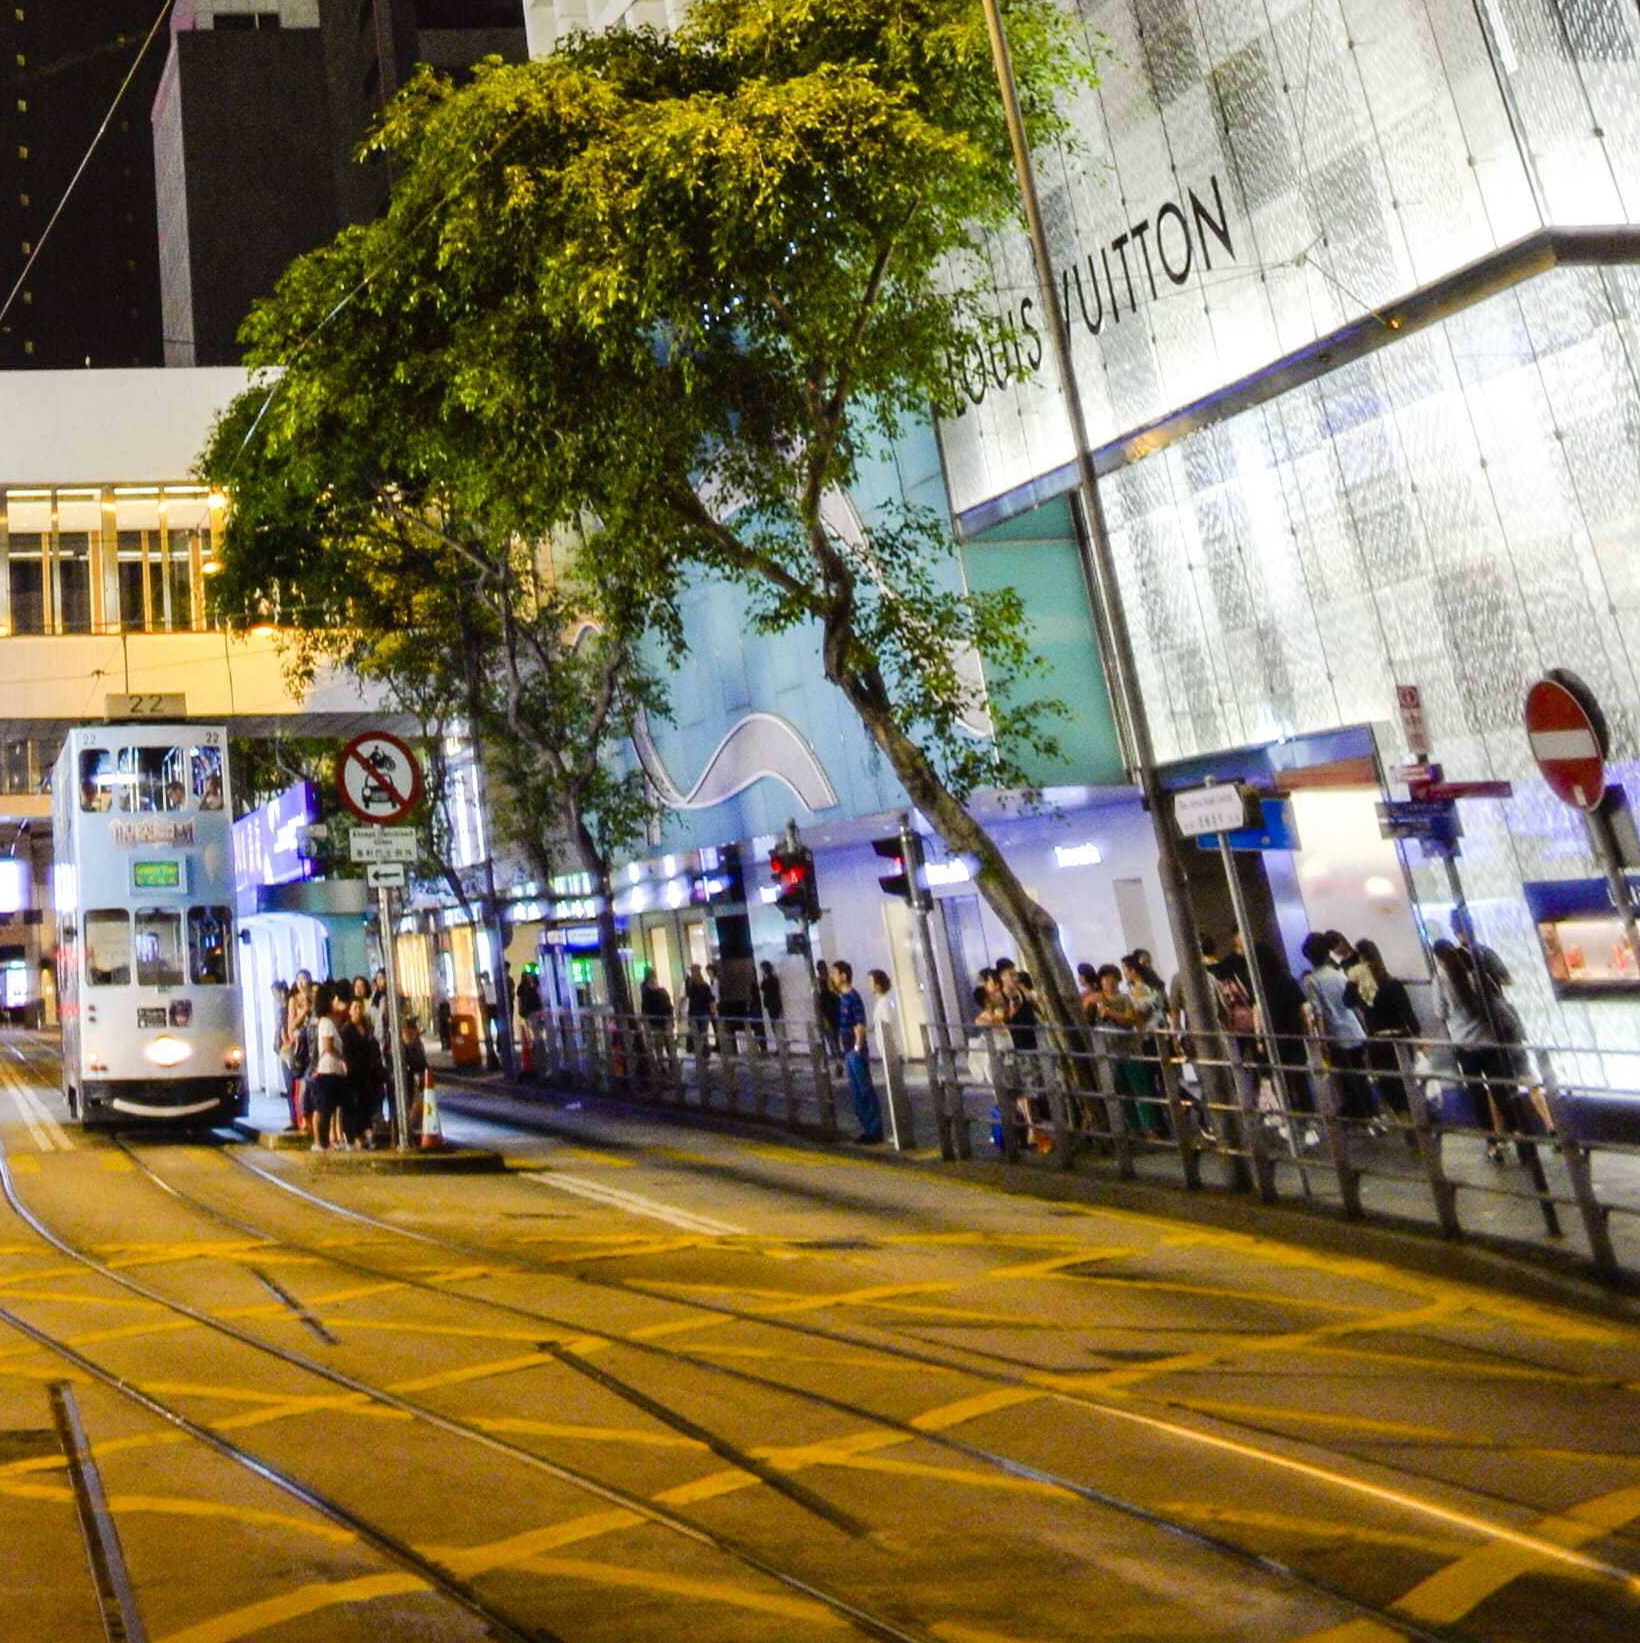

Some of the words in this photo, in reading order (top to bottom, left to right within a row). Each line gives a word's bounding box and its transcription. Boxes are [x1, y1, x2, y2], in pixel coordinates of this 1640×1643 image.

[129, 694, 164, 714] 22
[82, 734, 97, 745] 22
[205, 732, 220, 744] 22
